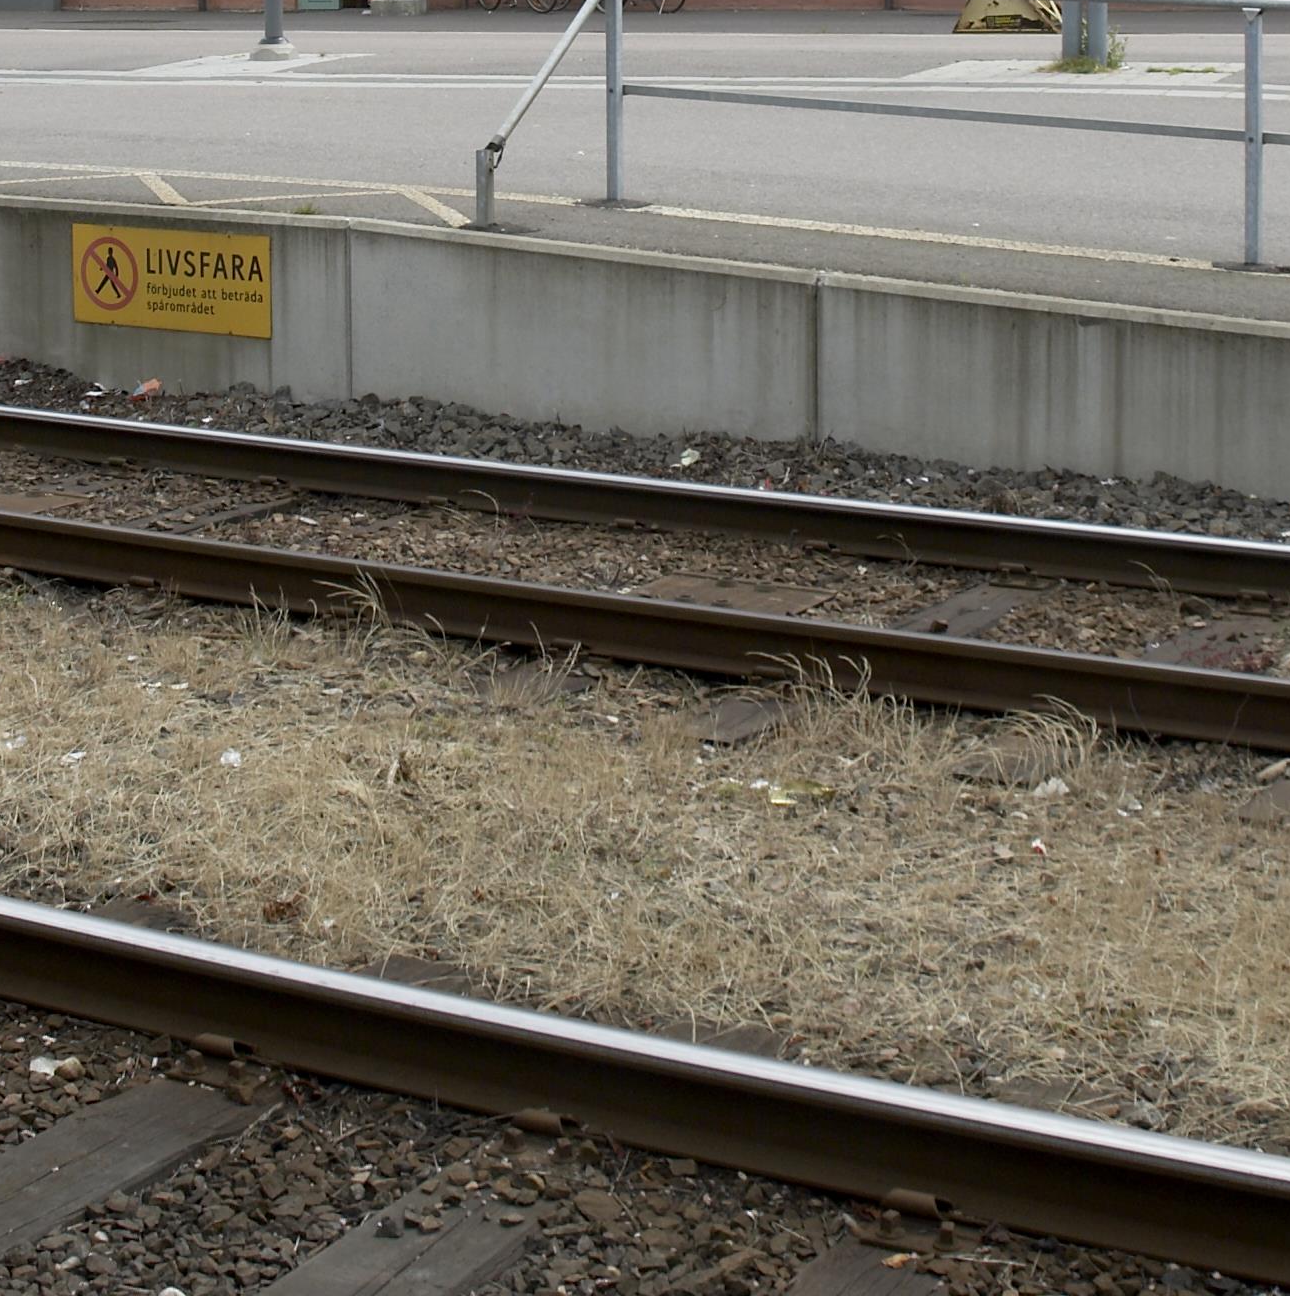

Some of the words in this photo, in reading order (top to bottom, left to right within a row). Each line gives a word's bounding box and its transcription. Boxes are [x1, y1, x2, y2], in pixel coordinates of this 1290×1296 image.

[146, 247, 264, 283] LIVSFARA
[146, 282, 197, 299] förbjudet
[201, 289, 217, 300] att
[221, 288, 264, 303] beträda
[146, 300, 215, 315] spårområdet
